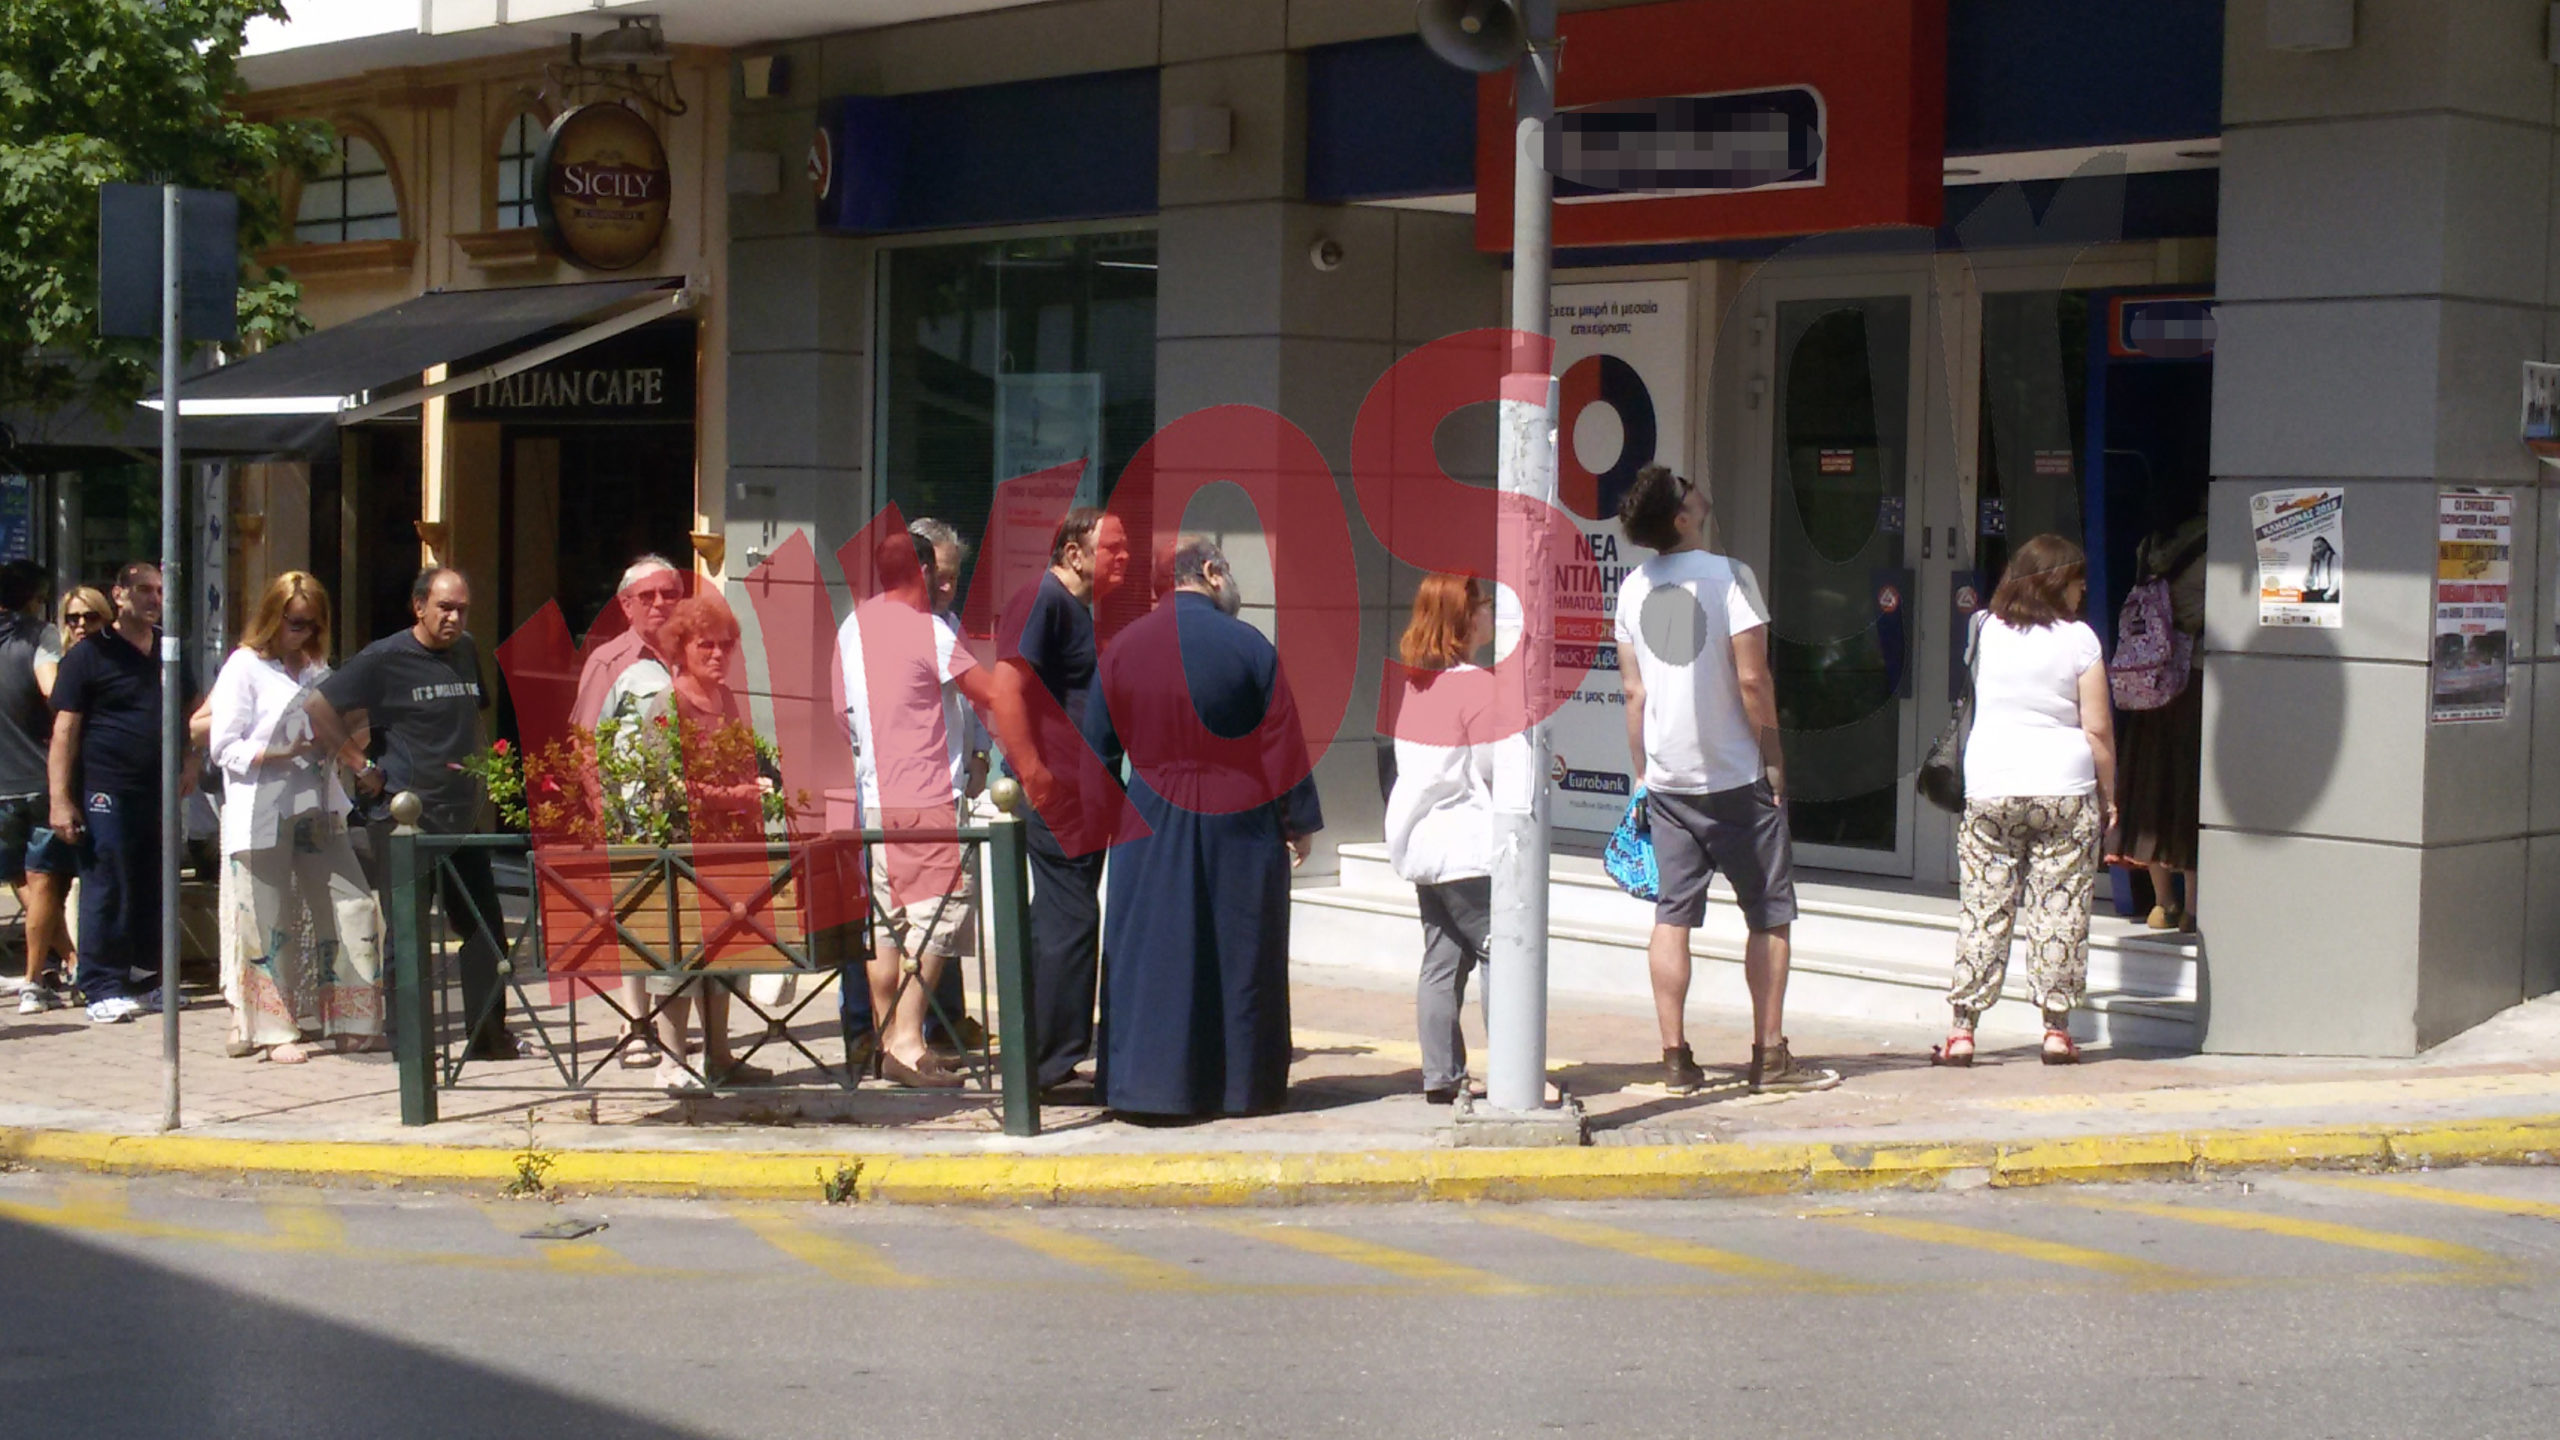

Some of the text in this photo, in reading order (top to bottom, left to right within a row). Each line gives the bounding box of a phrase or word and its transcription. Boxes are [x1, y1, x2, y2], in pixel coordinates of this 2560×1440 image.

[564, 165, 653, 198] SICILY
[585, 367, 663, 405] CAFE
[1575, 533, 1618, 562] ΝΕΑ
[1568, 772, 1624, 793] Eurobank
